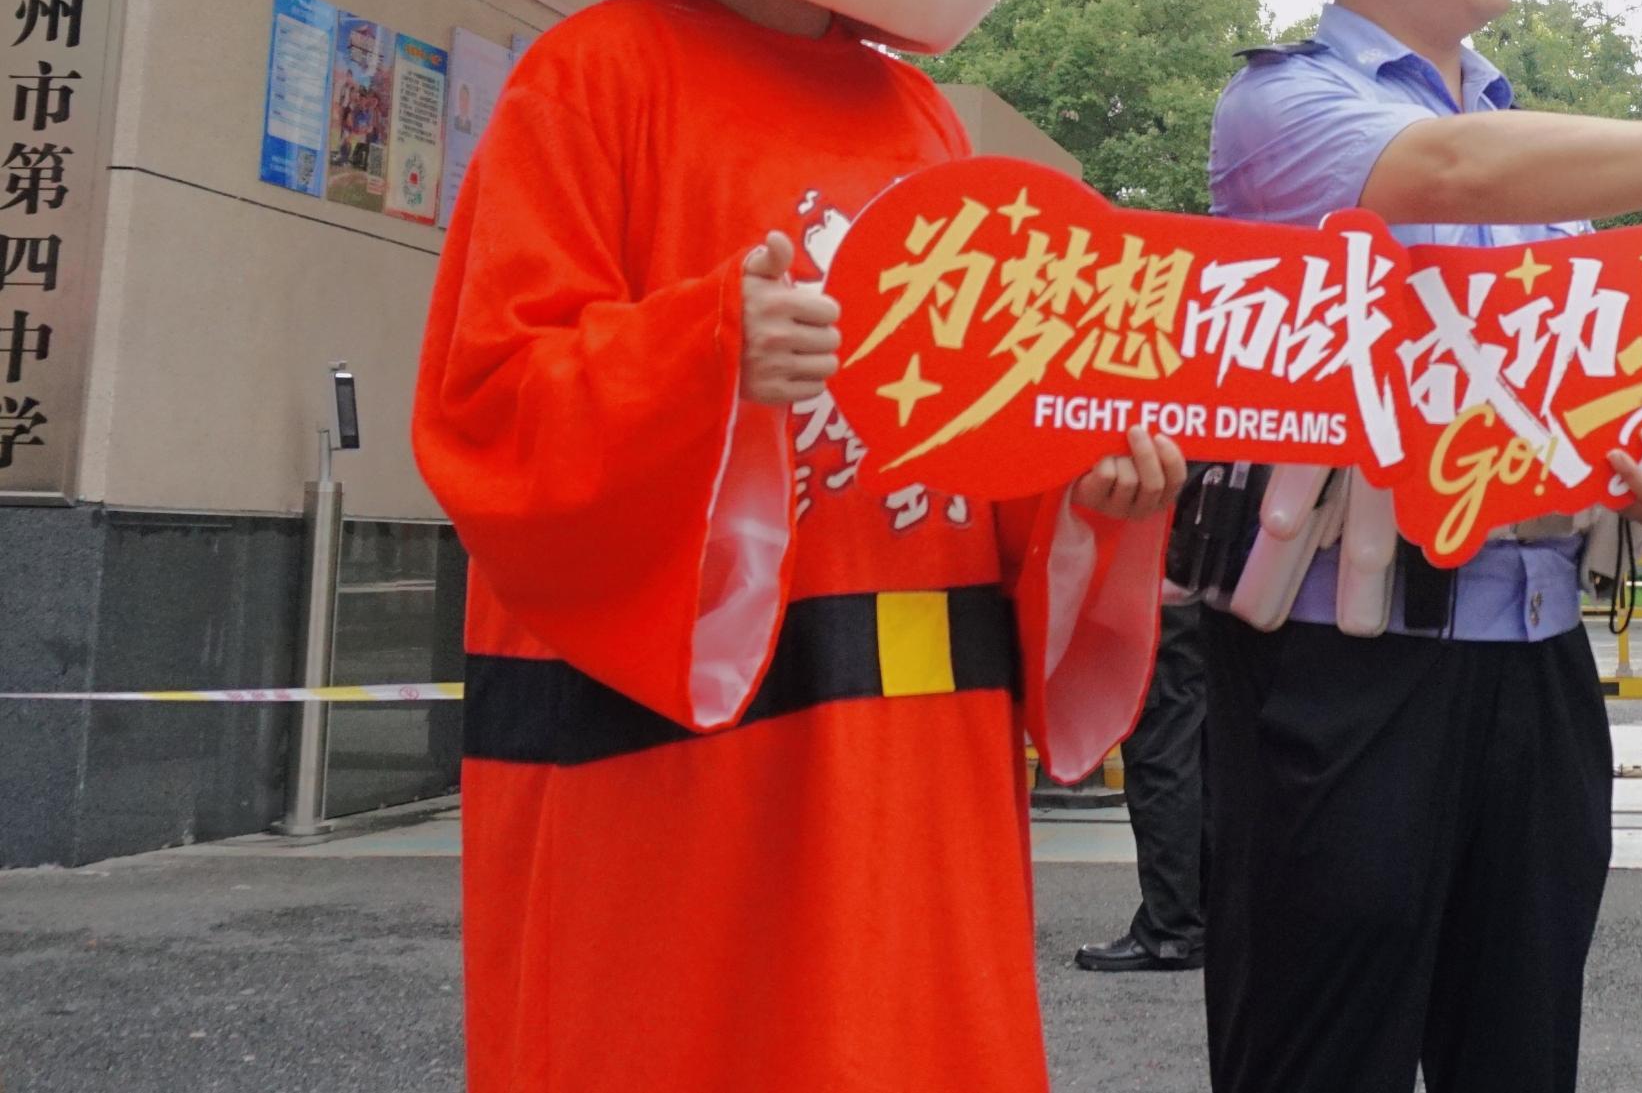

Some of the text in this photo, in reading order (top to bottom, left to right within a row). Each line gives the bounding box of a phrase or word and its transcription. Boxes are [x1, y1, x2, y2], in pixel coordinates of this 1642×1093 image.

[842, 196, 1405, 474] 为梦想而战
[1034, 394, 1347, 445] FIGHT FOR DREAMS
[1429, 404, 1558, 555] Go!
